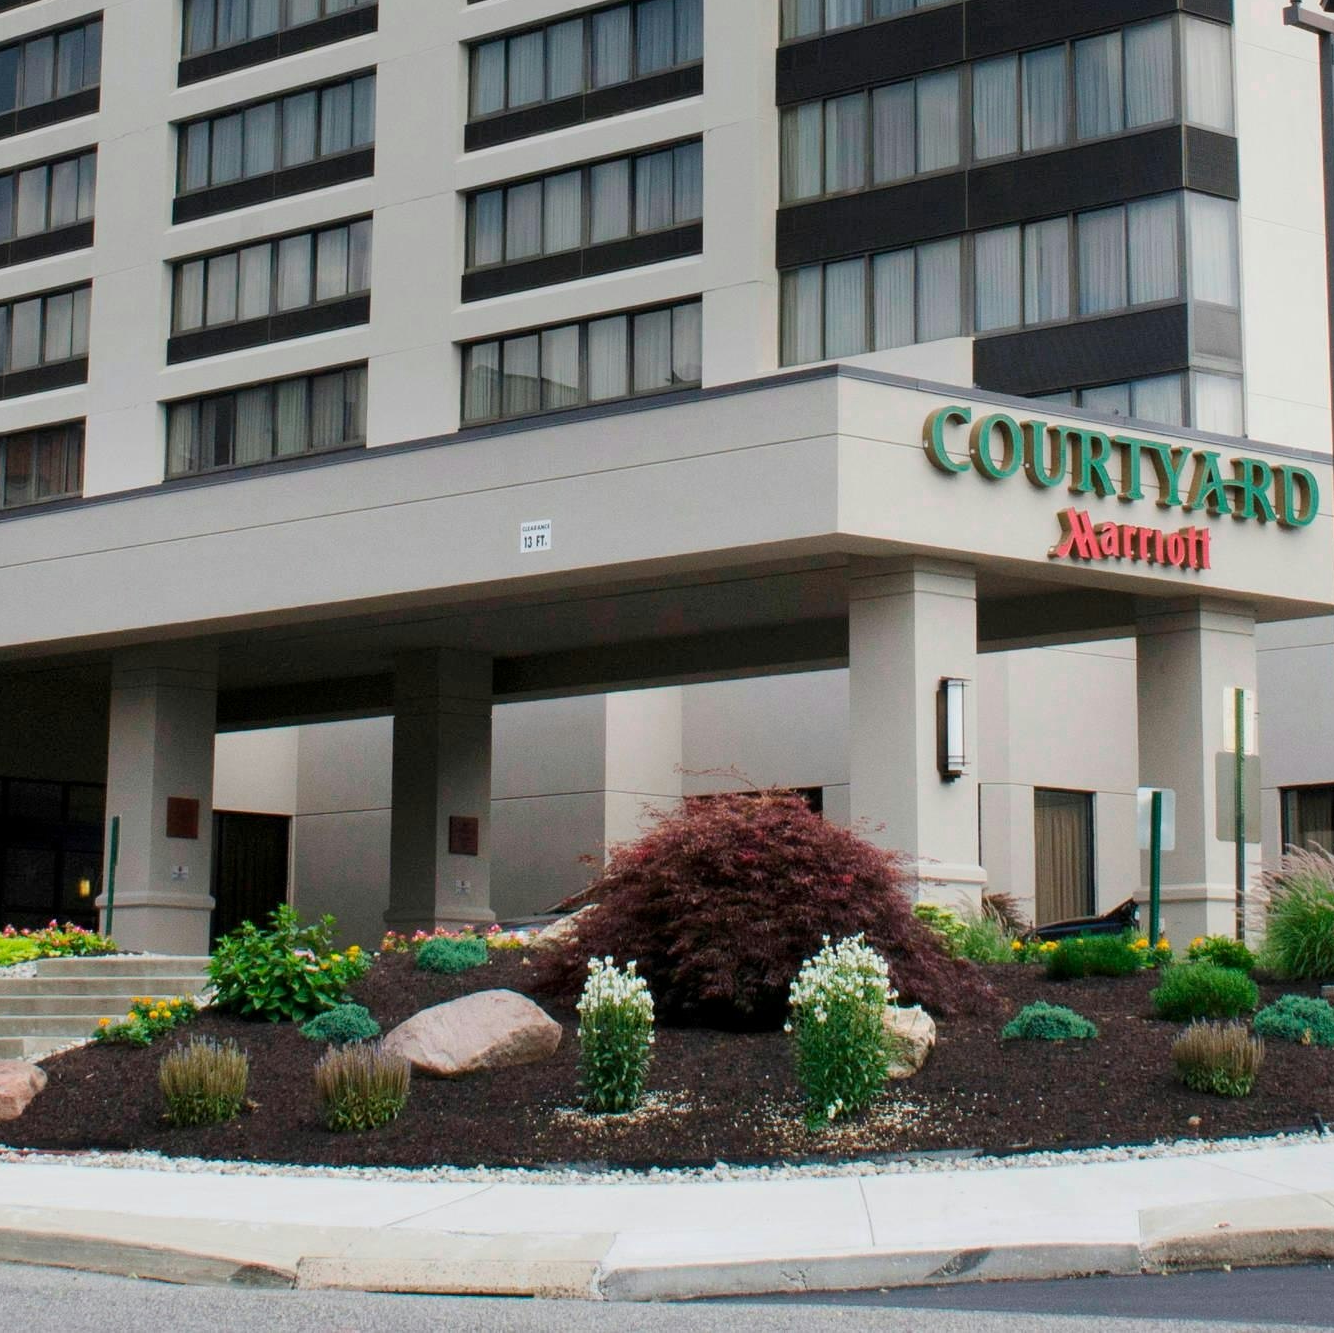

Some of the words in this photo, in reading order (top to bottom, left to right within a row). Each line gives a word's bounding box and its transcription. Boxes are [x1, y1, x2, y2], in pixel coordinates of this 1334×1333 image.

[923, 405, 1320, 528] COURTYARD
[524, 536, 533, 549] 13
[1048, 507, 1212, 570] Marriott
